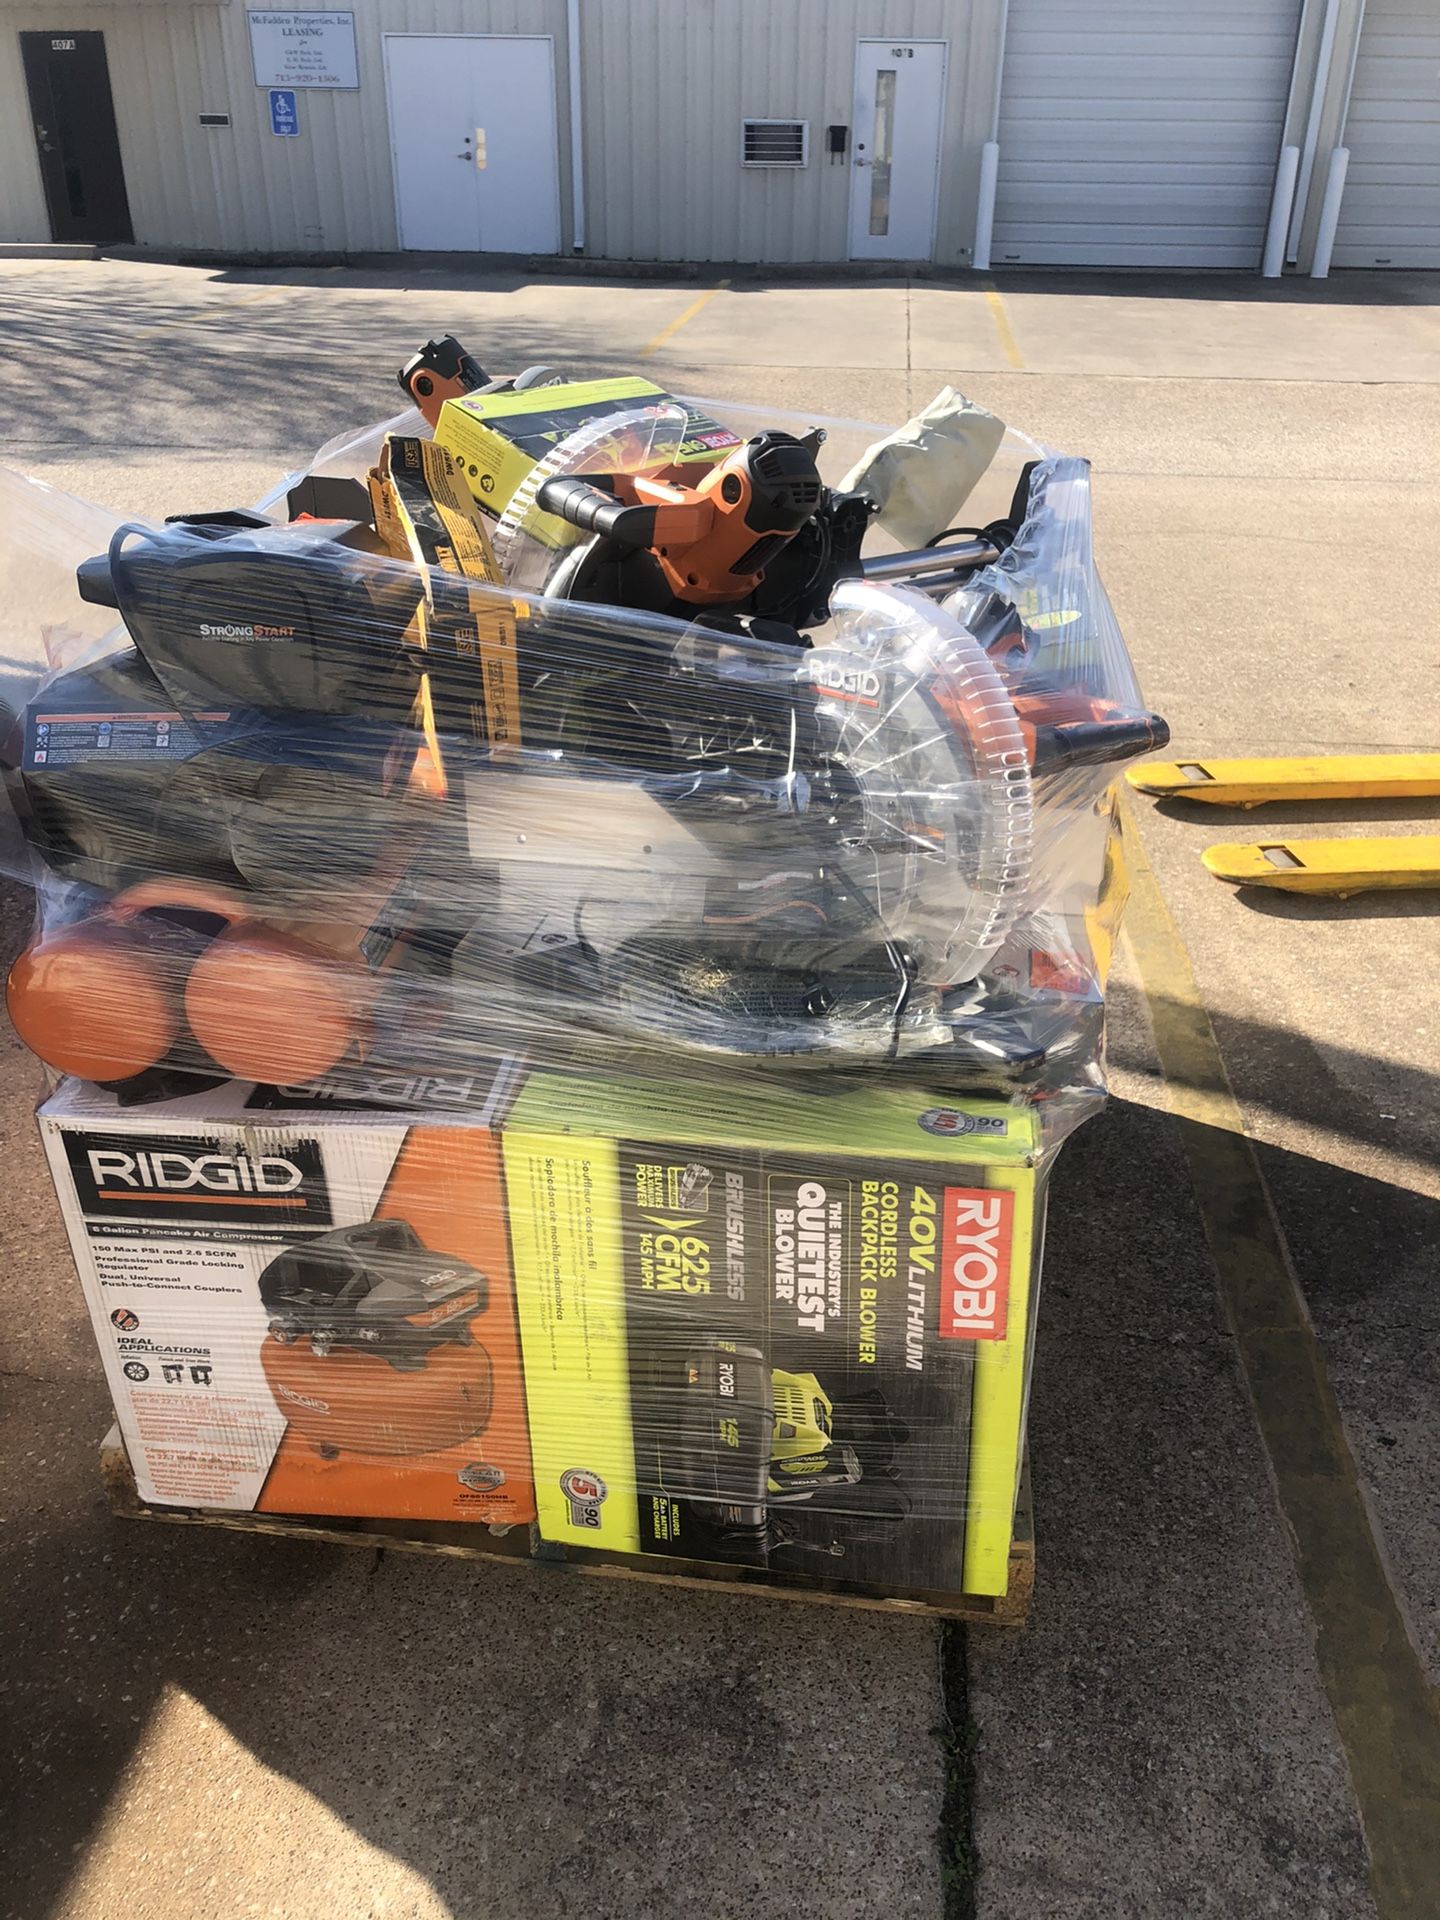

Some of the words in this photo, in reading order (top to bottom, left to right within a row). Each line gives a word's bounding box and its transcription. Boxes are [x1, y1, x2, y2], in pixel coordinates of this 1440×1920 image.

[282, 28, 323, 36] LEASING
[978, 1117, 1004, 1127] 90
[87, 1150, 303, 1192] RIDGID
[582, 1160, 593, 1203] Souffleur
[636, 1164, 648, 1207] POWER
[654, 1165, 664, 1209] DELIVERS
[545, 1158, 557, 1208] Sopladora
[551, 1225, 561, 1263] mochila
[585, 1216, 596, 1233] dos
[829, 1202, 842, 1229] THE
[103, 1226, 139, 1235] Gallon
[142, 1228, 191, 1238] Pancake
[213, 1231, 283, 1242] Compressor
[640, 1233, 653, 1255] 145
[725, 1172, 745, 1301] BRUSHLESS
[860, 1181, 878, 1282] BACKPACK
[879, 1181, 899, 1279] CORDLESS
[92, 1245, 111, 1253] 150
[205, 1250, 237, 1258] SCFM
[587, 1235, 596, 1258] sans
[796, 1182, 827, 1332] QUIETEST
[95, 1255, 163, 1265] Professional
[166, 1259, 198, 1267] Grade
[201, 1261, 244, 1270] Locking
[97, 1263, 149, 1272] Regulator
[641, 1257, 654, 1289] MPH
[656, 1234, 681, 1290] CFM
[681, 1237, 711, 1295] 625
[828, 1233, 842, 1317] INDUSTRY'S
[952, 1198, 1001, 1330] RYOBI
[100, 1273, 127, 1282] Dual,
[129, 1275, 181, 1283] Universal
[101, 1280, 191, 1290] Push-to-Connect
[194, 1285, 242, 1294] Couplers
[858, 1288, 877, 1364] BLOWER
[117, 1337, 153, 1345] IDEAL
[118, 1344, 211, 1355] APPLICATIONS
[719, 1363, 734, 1397] RYOBI
[727, 1418, 739, 1449] 145
[571, 1477, 597, 1498] 5
[652, 1496, 660, 1510] AND
[585, 1508, 599, 1527] 90
[653, 1511, 661, 1539] CHARGER
[660, 1515, 668, 1540] BATTERY
[672, 1504, 681, 1536] INCLUDES
